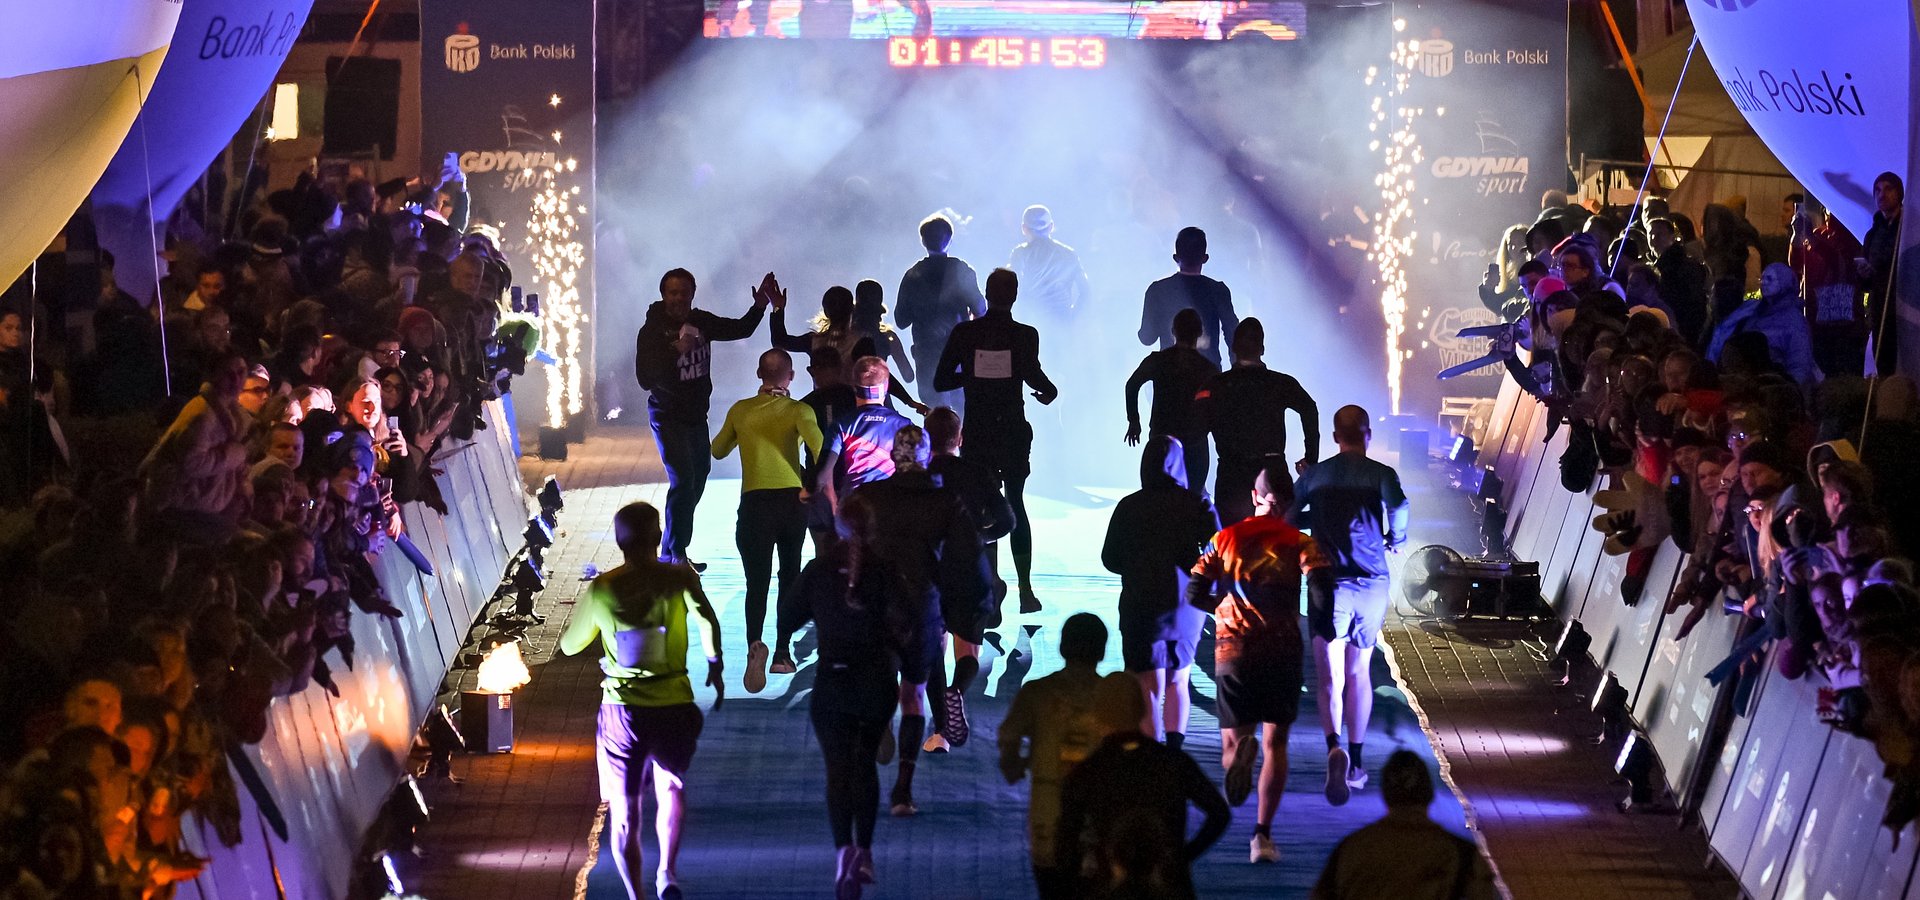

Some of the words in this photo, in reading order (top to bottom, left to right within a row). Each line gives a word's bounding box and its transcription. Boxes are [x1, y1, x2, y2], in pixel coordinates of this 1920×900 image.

[199, 10, 274, 60] Bank
[489, 44, 527, 59] Bank
[533, 44, 576, 60] Polski
[889, 36, 1106, 66] 01:45:53
[1464, 50, 1500, 65] Bank
[1506, 50, 1548, 65] Polski
[1722, 66, 1768, 112] ank
[1758, 69, 1865, 116] Polski
[459, 151, 555, 173] GDYNIA
[1431, 156, 1529, 178] GDYNIA
[503, 171, 551, 193] spor
[1477, 175, 1528, 197] sport
